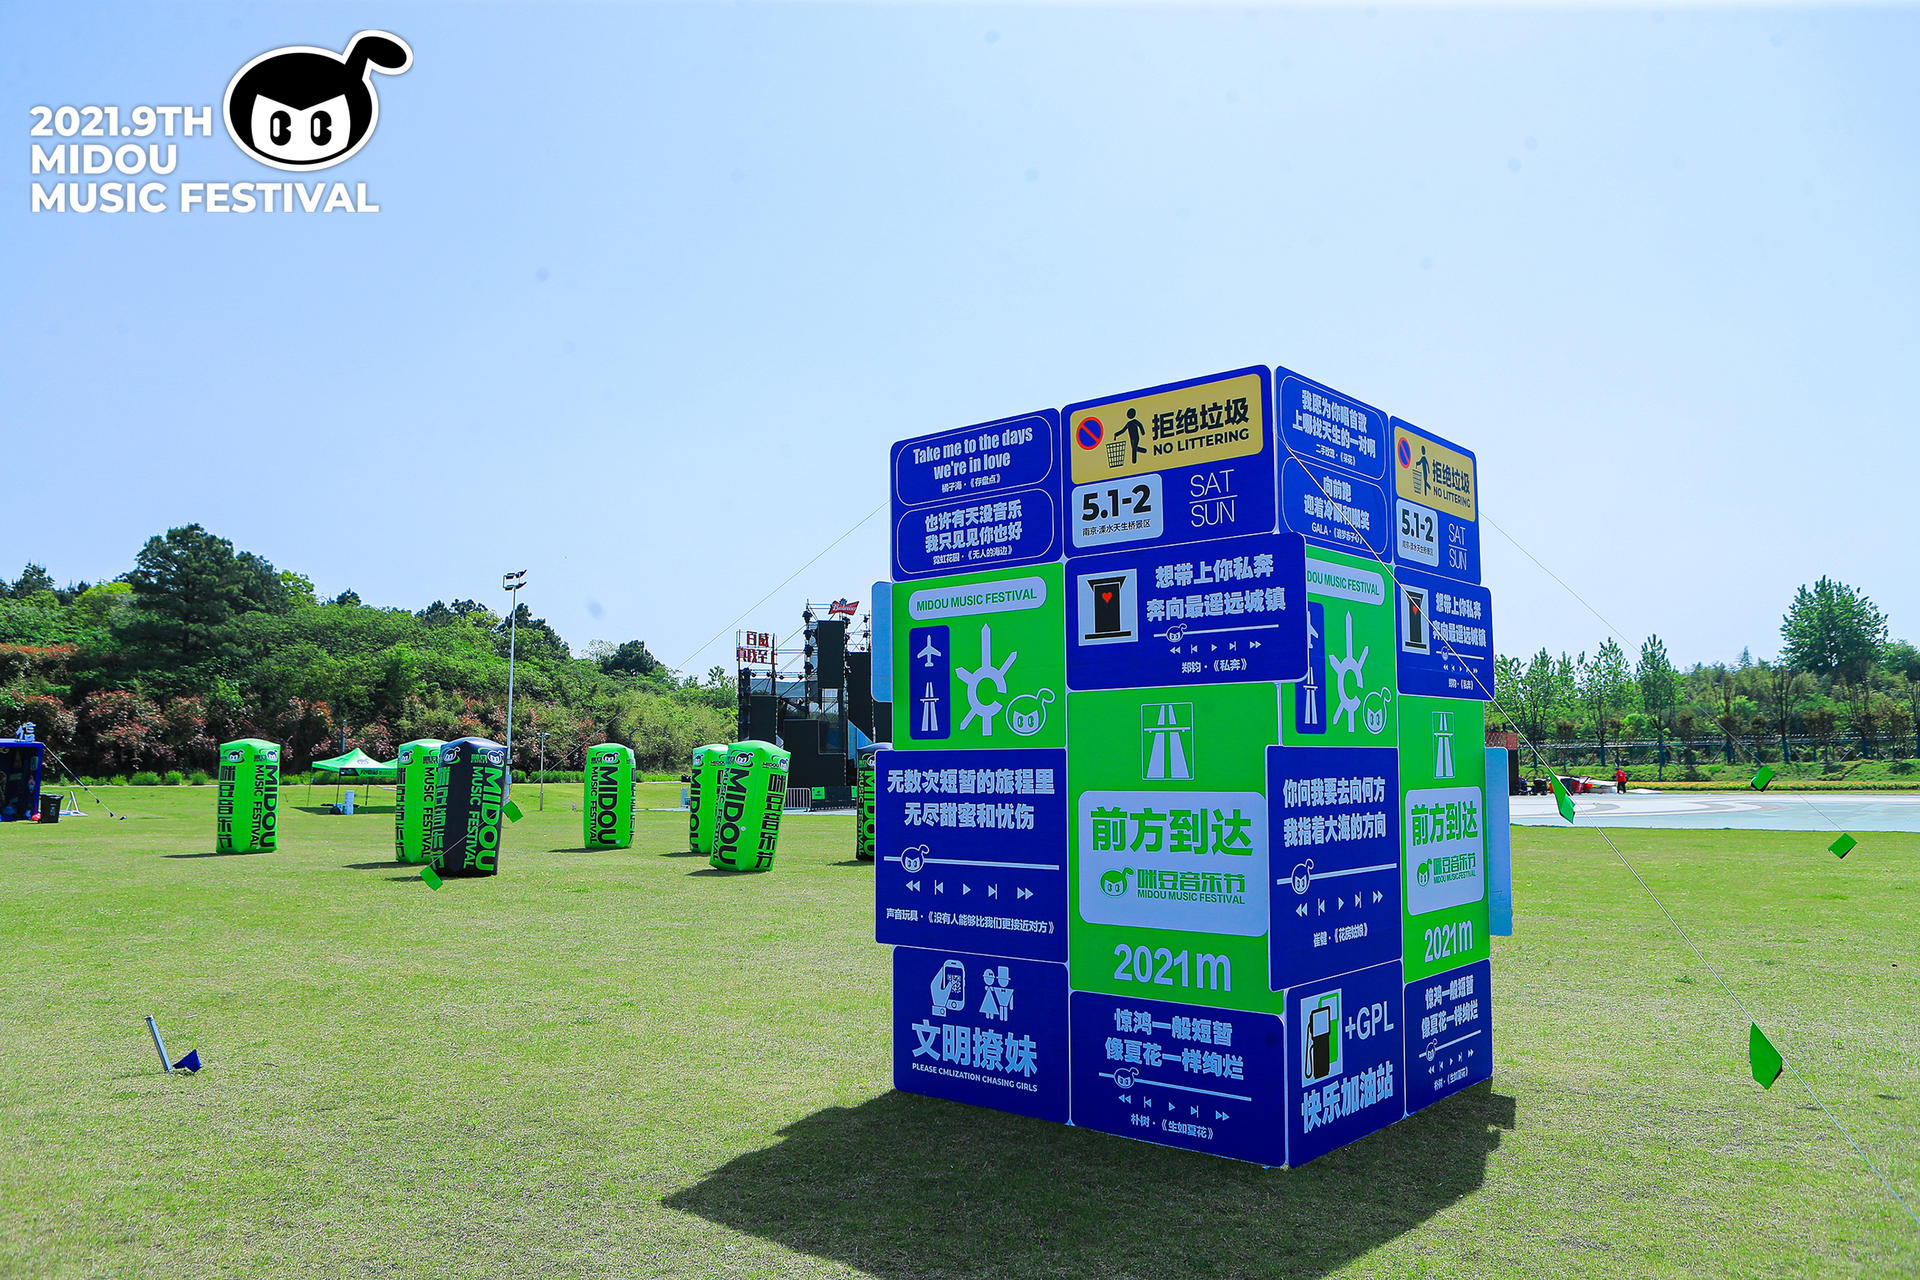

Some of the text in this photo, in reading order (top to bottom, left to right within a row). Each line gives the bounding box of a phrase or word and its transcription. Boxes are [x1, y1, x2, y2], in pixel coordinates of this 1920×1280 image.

[1152, 397, 1249, 440] 拒绝垃圾
[912, 427, 1033, 465] Take me to the days
[1153, 428, 1249, 456] NO LITTERING
[933, 452, 1011, 480] we're in love
[1190, 469, 1235, 497] SAT
[1432, 459, 1470, 494] 拒绝垃圾
[1082, 484, 1152, 521] 5.1-2
[1191, 500, 1235, 527] SUN
[1433, 486, 1471, 508] NO LITTERING
[925, 499, 1022, 532] 也许有天没音乐
[1401, 508, 1434, 543] 5.1-2
[925, 521, 1022, 553] 我只见见你也好
[1448, 523, 1466, 545] SAT
[1155, 553, 1274, 589] 想带上你私奔
[1449, 548, 1467, 570] SUN
[917, 588, 1037, 612] MIDOU MUSIC FESTIVAL
[1307, 570, 1380, 596] DOU MUSIC FESTIVAL
[1146, 586, 1286, 622] 奔向最遥远城镇
[254, 765, 264, 797] MUSIC
[423, 767, 435, 802] MUSIC
[470, 766, 484, 806] MUSIC
[590, 766, 598, 797] MUSIC
[719, 767, 730, 804] MUSIC
[887, 768, 1055, 795] 无数次短暂的旅程里
[1283, 776, 1385, 809] 你问我要去向何方
[260, 765, 278, 848] MIDOU
[475, 767, 503, 871] MIDOU
[589, 801, 598, 844] FESTIVAL
[598, 766, 619, 845] MIDOU
[689, 768, 702, 849] MIDOU
[719, 768, 750, 865] MIDOU
[864, 770, 875, 857] MIDOU
[904, 802, 1034, 829] 无尽甜蜜和忧伤
[1411, 800, 1478, 847] 前方到达
[249, 801, 263, 849] FESTIVAL
[421, 807, 434, 858] FESTIVAL
[463, 811, 480, 869] FESTIVAL
[712, 809, 723, 862] FESTIVAL
[1091, 807, 1253, 856] 前方到达
[1283, 811, 1387, 848] 我指着大海的方向
[1137, 869, 1245, 893] 咪豆音乐节
[1137, 889, 1245, 905] MIDOU MUSIC FESTIVAL
[1114, 1008, 1233, 1046] 惊鸿一般短暂
[1345, 1001, 1394, 1040] +GPL
[911, 1019, 1037, 1077] 文明撩妹
[1105, 1037, 1244, 1080] 像夏花一样绚烂
[912, 1063, 937, 1074] PLEASE
[982, 1075, 1014, 1088] CHASING
[1015, 1081, 1037, 1092] GIRLS
[1302, 1060, 1394, 1134] 快乐加油站
